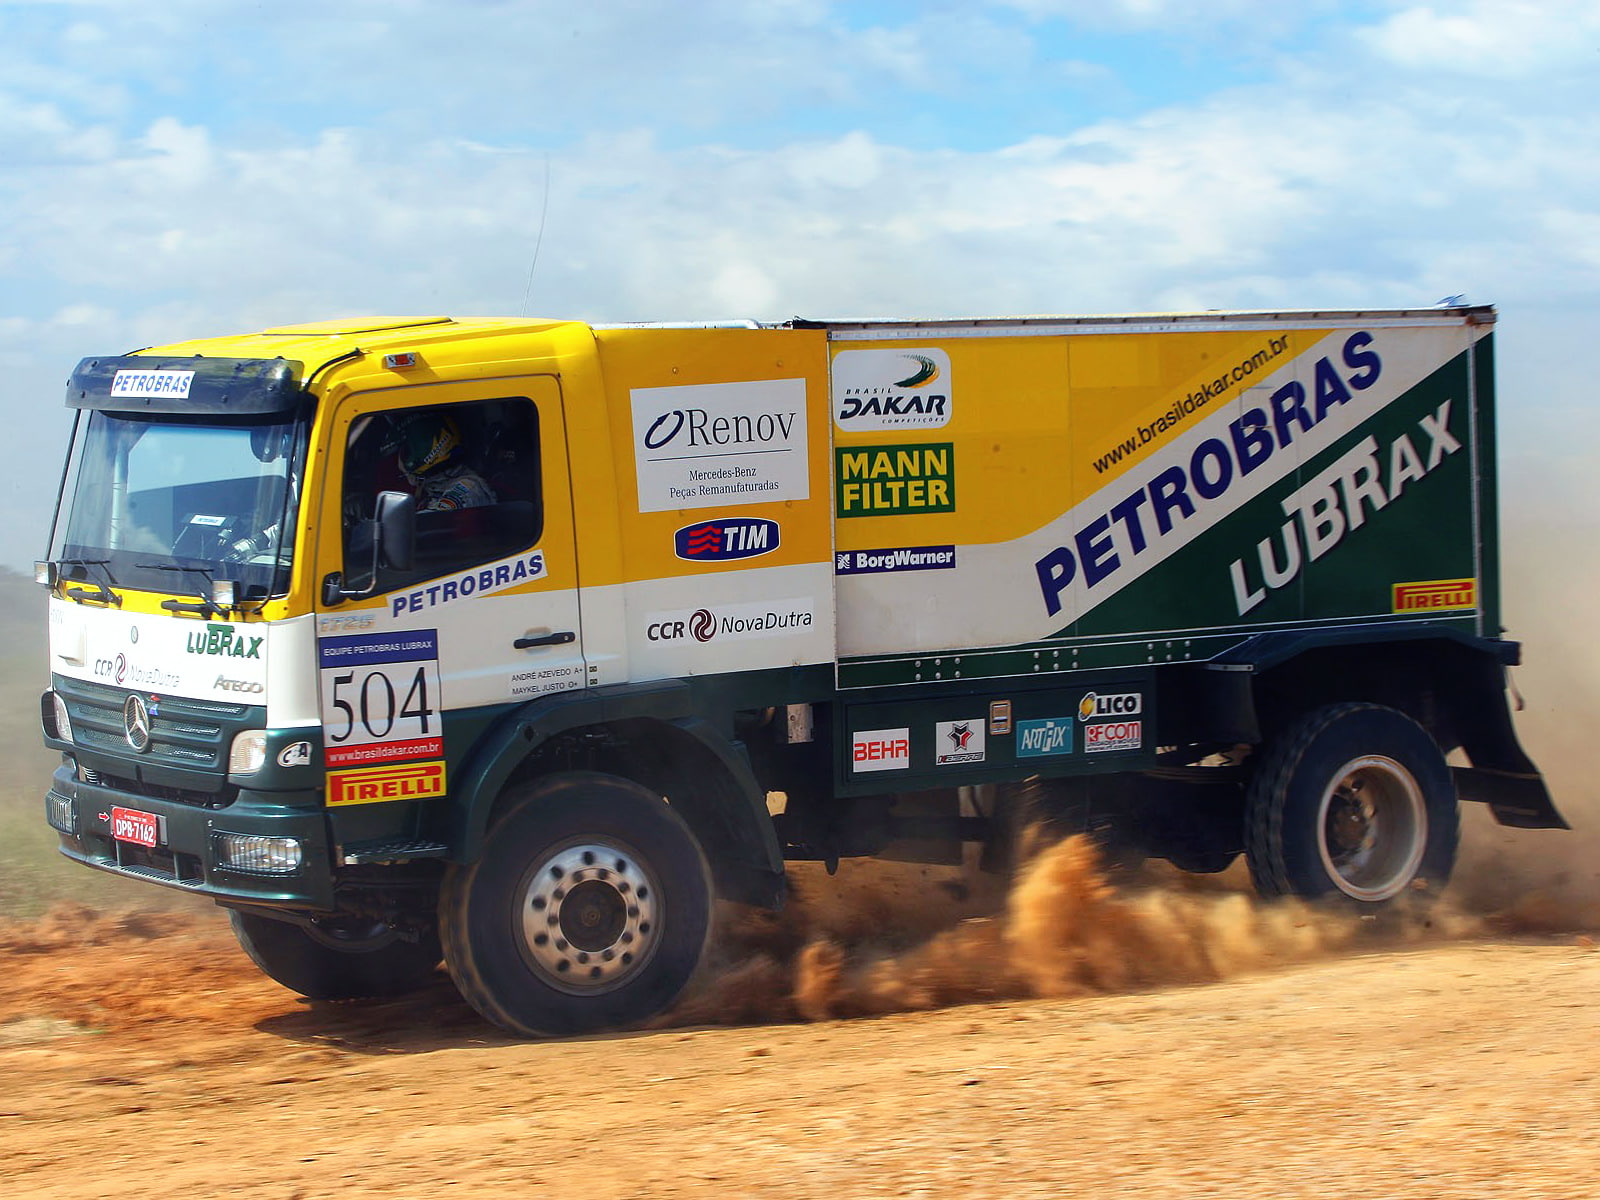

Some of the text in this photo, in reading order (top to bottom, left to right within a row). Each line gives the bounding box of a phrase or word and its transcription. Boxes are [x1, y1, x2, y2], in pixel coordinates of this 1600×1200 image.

[113, 374, 191, 393] PETROBRAS
[846, 387, 892, 395] BRASIL
[840, 394, 946, 420] DAKAR
[1093, 334, 1290, 474] www.brasildakar.com.br
[689, 467, 757, 482] Mercedes-Benz
[842, 449, 948, 481] MANN
[1035, 331, 1382, 618] PETROBRAS
[669, 480, 780, 501] Peças Remanufaturadas
[843, 479, 950, 511] FILTER
[1229, 398, 1462, 617] LUBRAX
[723, 524, 769, 552] TIM
[856, 550, 954, 570] BorgWarner
[392, 554, 543, 618] PETROBRAS
[1395, 582, 1474, 609] PIRELLI
[647, 611, 812, 641] CCR NovaDutra
[186, 623, 264, 660] LUBRAX
[323, 640, 433, 657] EQUIPE PETROBRAS LUBRAX
[538, 668, 571, 679] AZEVEDO
[512, 685, 541, 695] MAYKEL
[542, 682, 565, 692] JUSTO
[330, 666, 433, 743] 504
[1096, 695, 1138, 714] LICO
[329, 742, 440, 762] www.brasildakar.com.br
[853, 738, 909, 763] BEHR
[330, 765, 442, 802] PIRELLI
[115, 818, 155, 843] DPB-7162
